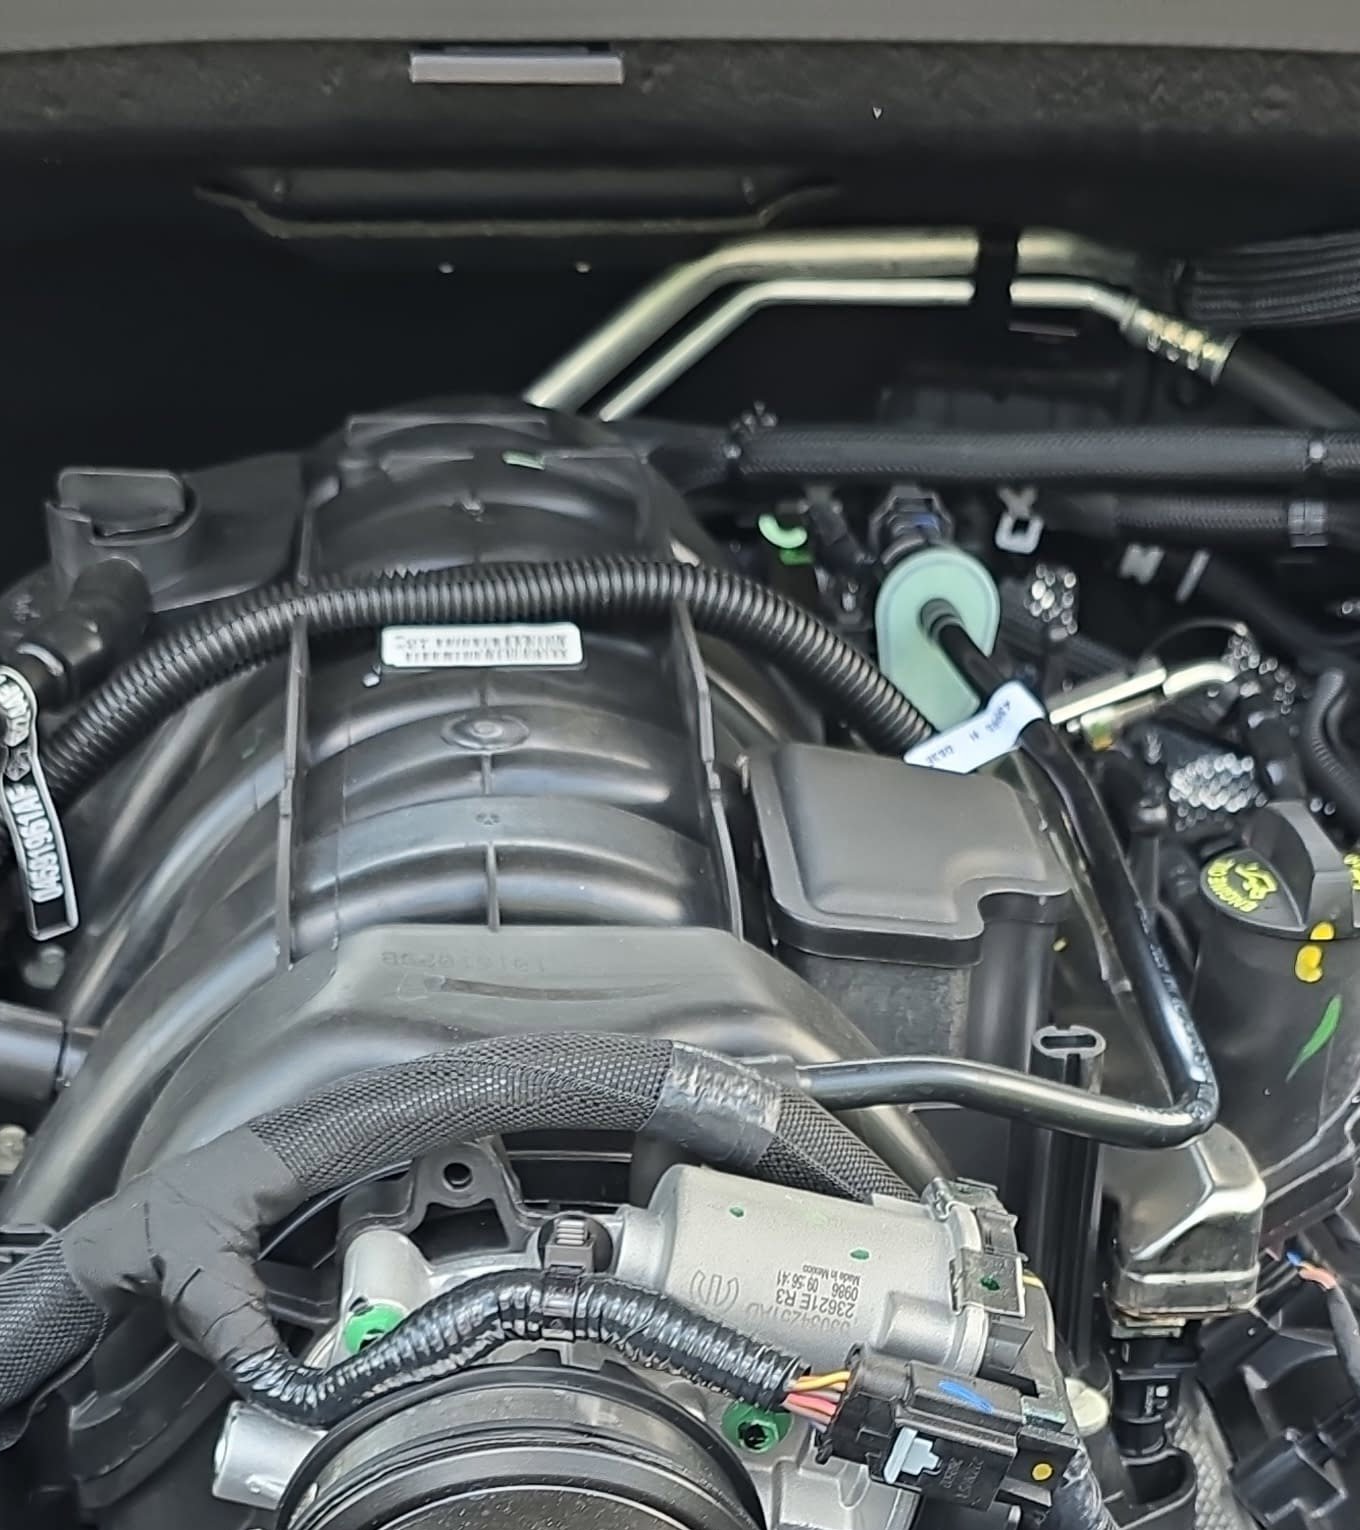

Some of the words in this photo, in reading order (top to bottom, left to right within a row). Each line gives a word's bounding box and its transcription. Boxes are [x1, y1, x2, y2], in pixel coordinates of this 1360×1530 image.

[802, 1264, 829, 1281] Mexico
[839, 1271, 861, 1286] Made
[775, 1289, 797, 1307] R3
[831, 1282, 859, 1302] 0986
[800, 1293, 855, 1319] 23621E
